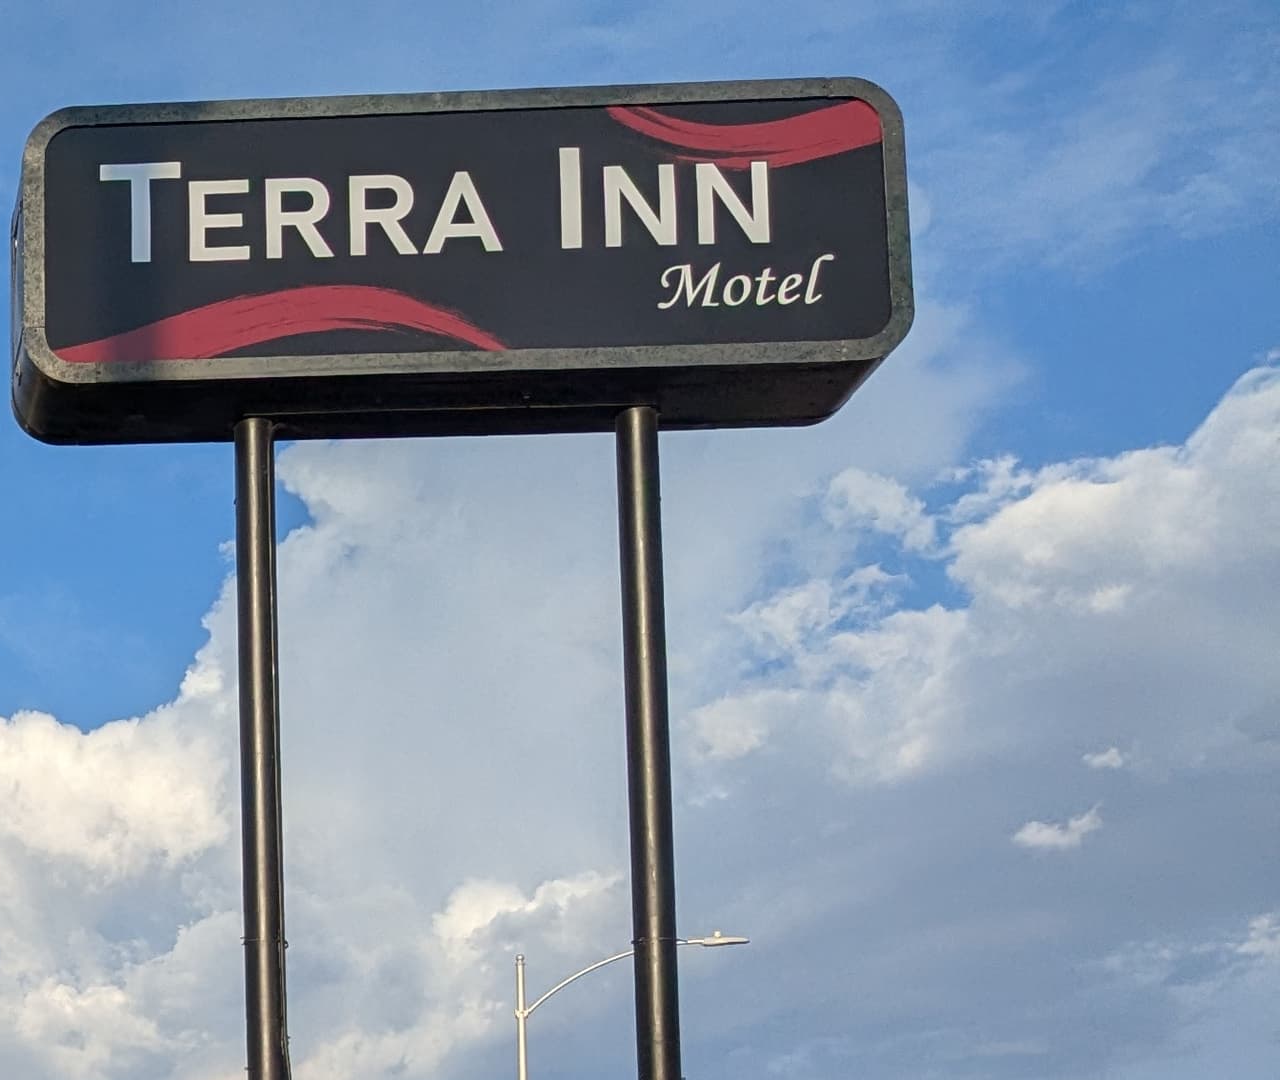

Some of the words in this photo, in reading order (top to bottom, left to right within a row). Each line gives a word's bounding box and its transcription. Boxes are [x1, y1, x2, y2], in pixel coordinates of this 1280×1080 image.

[99, 161, 504, 263] TERRA
[558, 147, 770, 249] INN
[657, 254, 835, 309] Motel
